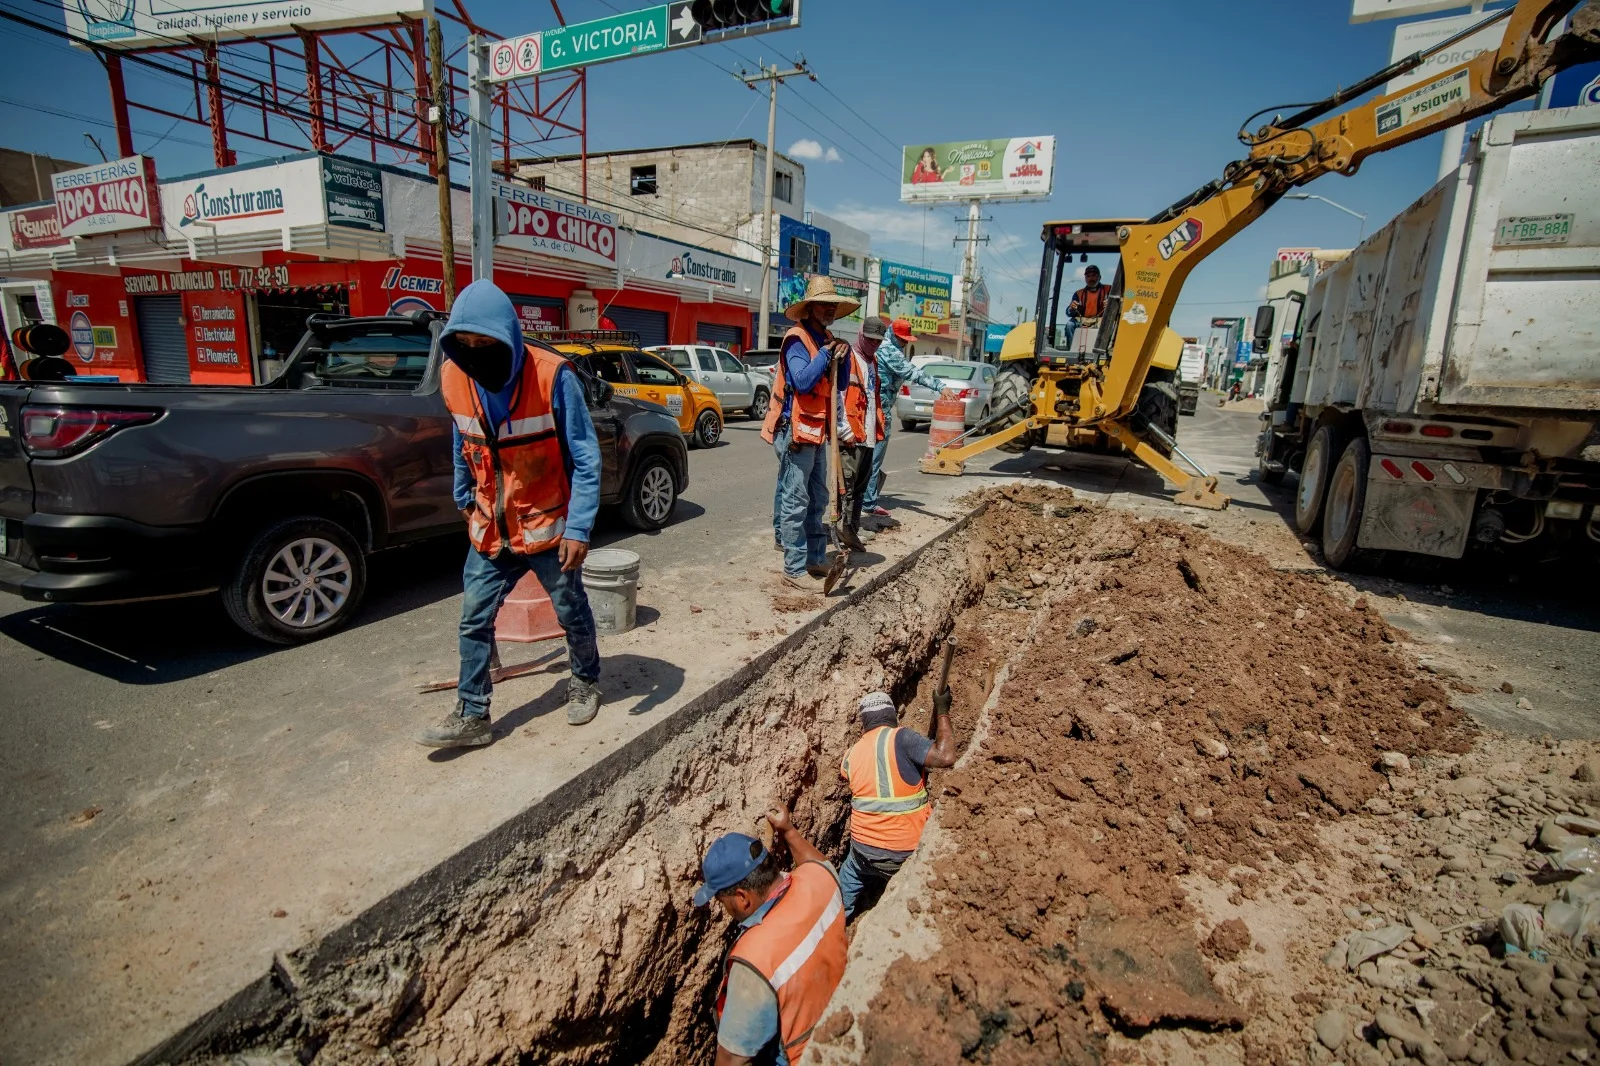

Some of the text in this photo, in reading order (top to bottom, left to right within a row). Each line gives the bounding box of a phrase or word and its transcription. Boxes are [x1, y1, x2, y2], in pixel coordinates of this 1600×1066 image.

[157, 6, 312, 30] calidad, higiene y servicio
[544, 27, 567, 37] AVENIDA
[551, 20, 657, 58] G. VICTORIA
[497, 50, 511, 65] 50
[1412, 86, 1462, 111] MADISA
[1380, 115, 1399, 130] CAT
[56, 162, 137, 189] FERRETERIAS
[333, 174, 381, 192] valetodo
[57, 180, 144, 225] TOPO CHICO
[202, 188, 283, 217] Construrama
[508, 202, 614, 257] OPO CHICO
[1158, 221, 1192, 259] CAT
[551, 241, 561, 250] de
[124, 274, 158, 293] SERVICIO
[161, 273, 168, 291] A
[170, 270, 214, 290] DOMICILIO
[687, 257, 736, 283] Construrama
[401, 276, 442, 292] CEMEX
[905, 282, 949, 298] BOLSA NEGRA
[203, 327, 236, 342] Electricidad
